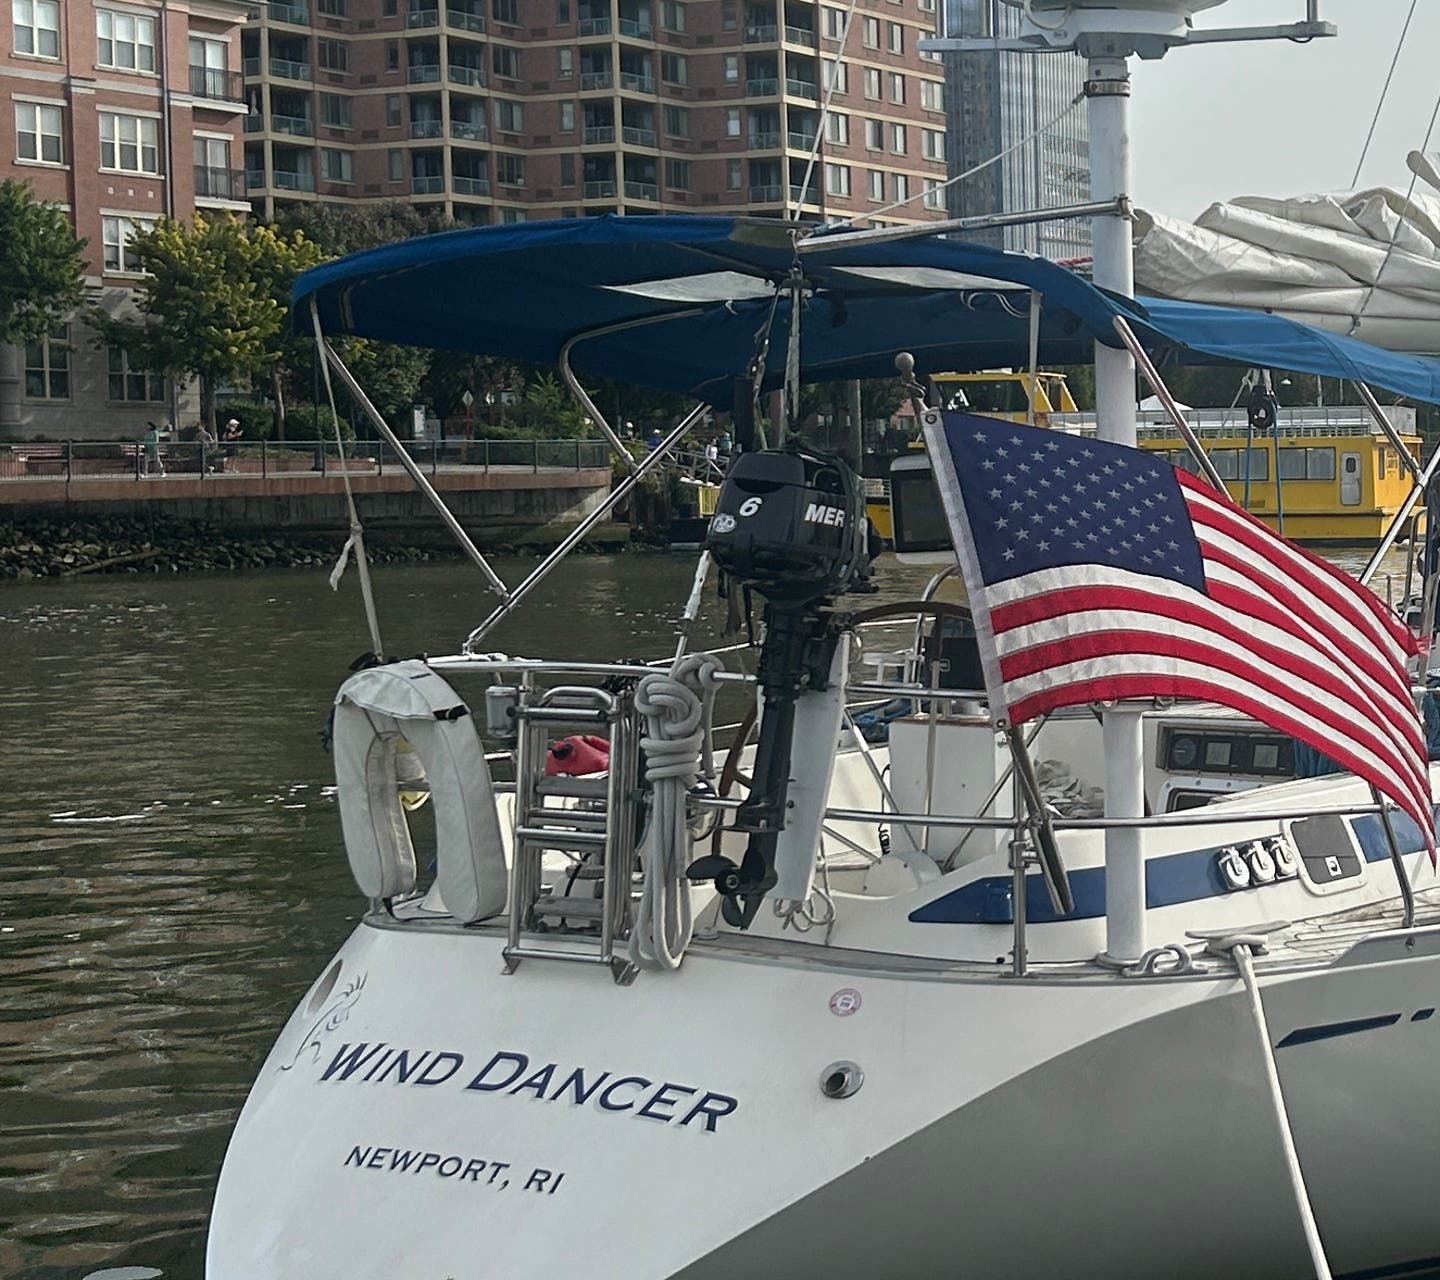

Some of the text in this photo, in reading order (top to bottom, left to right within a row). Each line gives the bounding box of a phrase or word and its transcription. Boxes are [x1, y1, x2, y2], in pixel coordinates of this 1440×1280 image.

[739, 496, 763, 517] 6
[319, 1043, 738, 1132] WIND DANCER
[344, 1145, 565, 1194] NEWPORT, RI
